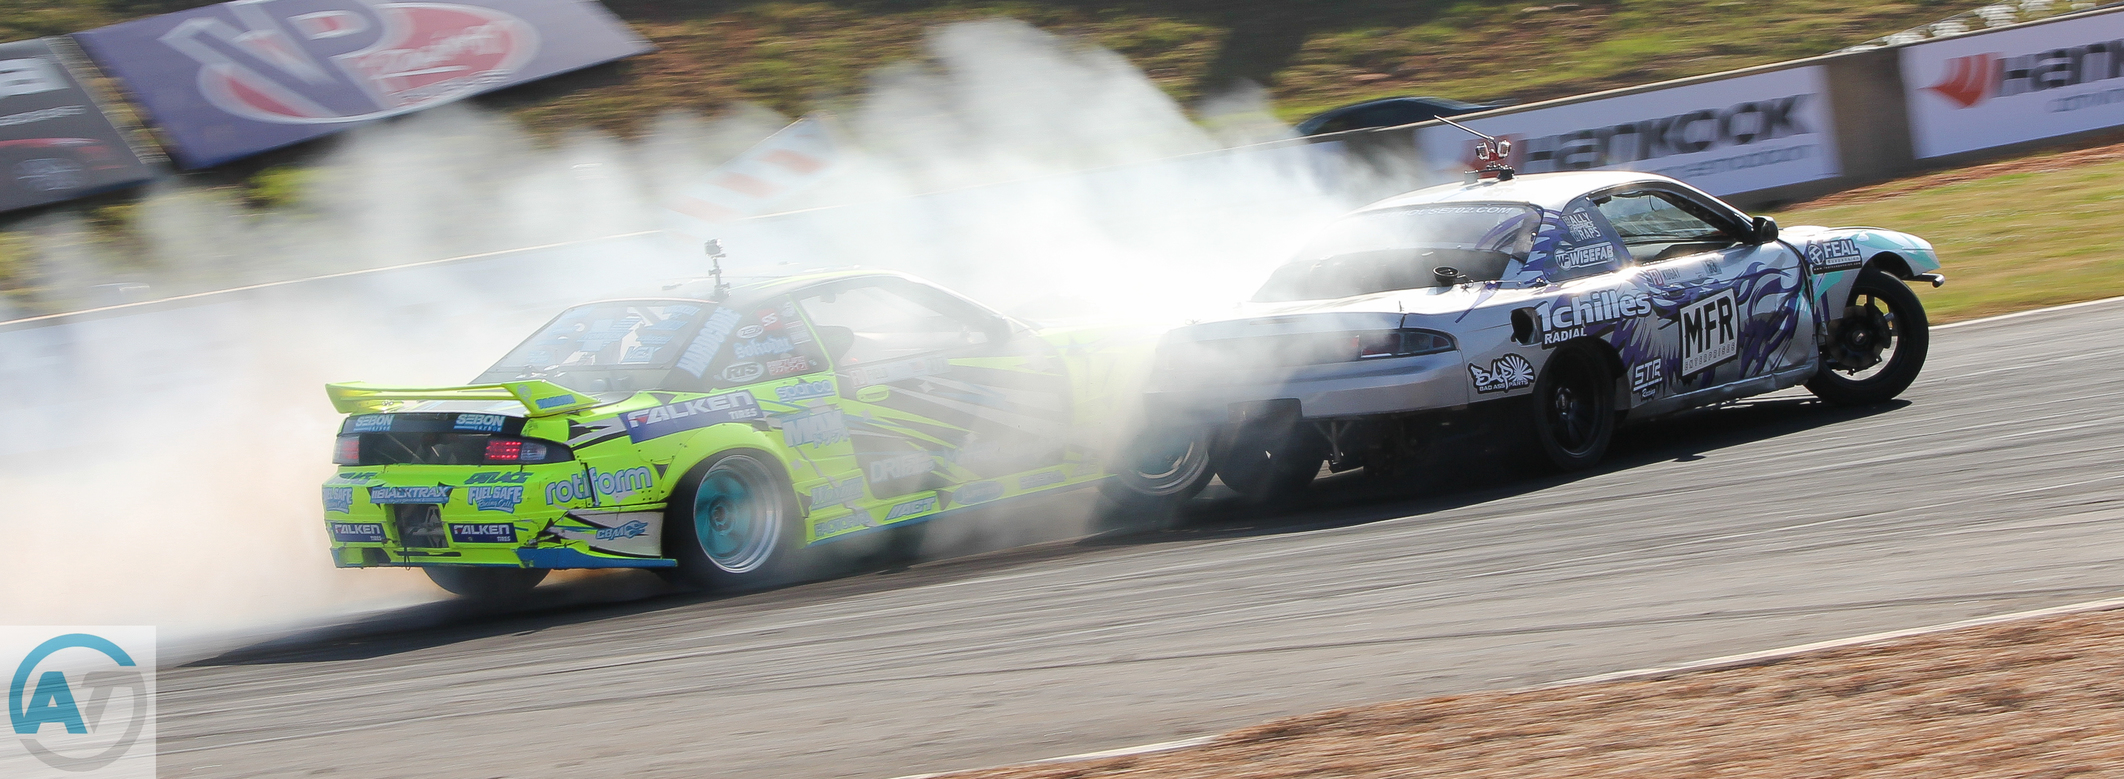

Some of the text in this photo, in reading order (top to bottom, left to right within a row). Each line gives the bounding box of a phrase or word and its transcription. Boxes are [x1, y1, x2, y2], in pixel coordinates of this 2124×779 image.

[1570, 245, 1614, 266] WISEFAB
[1823, 240, 1859, 259] FEAL
[1544, 327, 1588, 345] RADIAL
[1683, 296, 1735, 359] MFR
[1635, 358, 1662, 386] STR
[776, 380, 833, 402] sparco
[627, 391, 754, 428] FALKEN
[728, 407, 757, 421] TIRES
[782, 409, 845, 448] MAX
[468, 486, 523, 505] FUEL SAFE
[545, 466, 653, 507] rotiform
[335, 524, 381, 535] FALKEN
[453, 524, 511, 535] FALKEN
